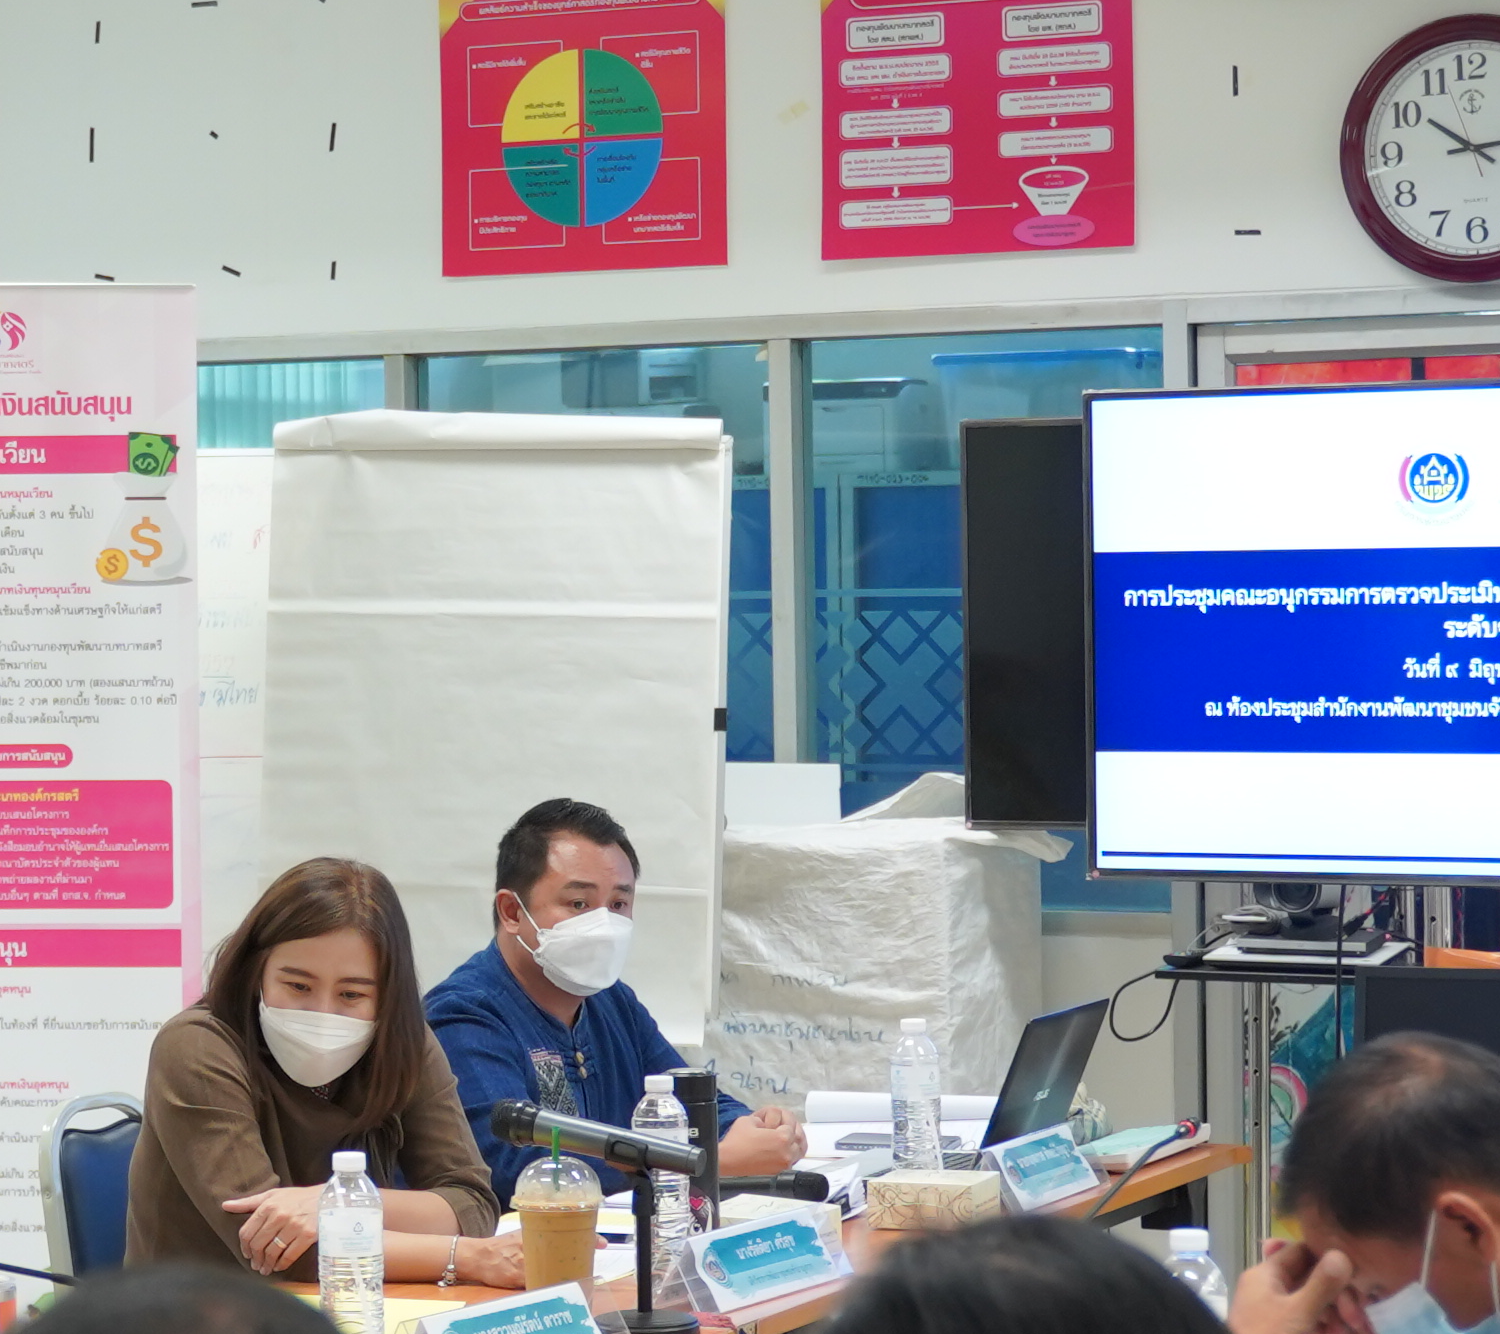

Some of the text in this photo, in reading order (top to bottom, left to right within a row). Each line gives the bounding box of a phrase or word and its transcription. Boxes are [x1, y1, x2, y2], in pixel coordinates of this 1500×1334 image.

[1452, 52, 1487, 81] 12
[1421, 68, 1449, 97] 11
[1391, 101, 1422, 129] 10
[1380, 141, 1404, 167] 9
[1394, 180, 1417, 207] 8
[1428, 209, 1451, 237] 7
[1466, 217, 1489, 244] 6
[50, 510, 64, 519] คน
[69, 505, 94, 519] ขึ้นไป
[0, 527, 25, 539] เดือน
[1403, 652, 1441, 679] วันที่
[66, 680, 86, 688] บาท
[90, 677, 174, 690] (สองแสนบาทถ้วน)
[30, 698, 48, 706] งวด
[52, 691, 90, 706] ดอกเบี้ย
[95, 694, 126, 706] ร้อยละ
[131, 696, 152, 705] 0.10
[1205, 701, 1222, 717] ณ
[34, 889, 59, 900] ตามที่
[95, 890, 126, 900] กำหนด
